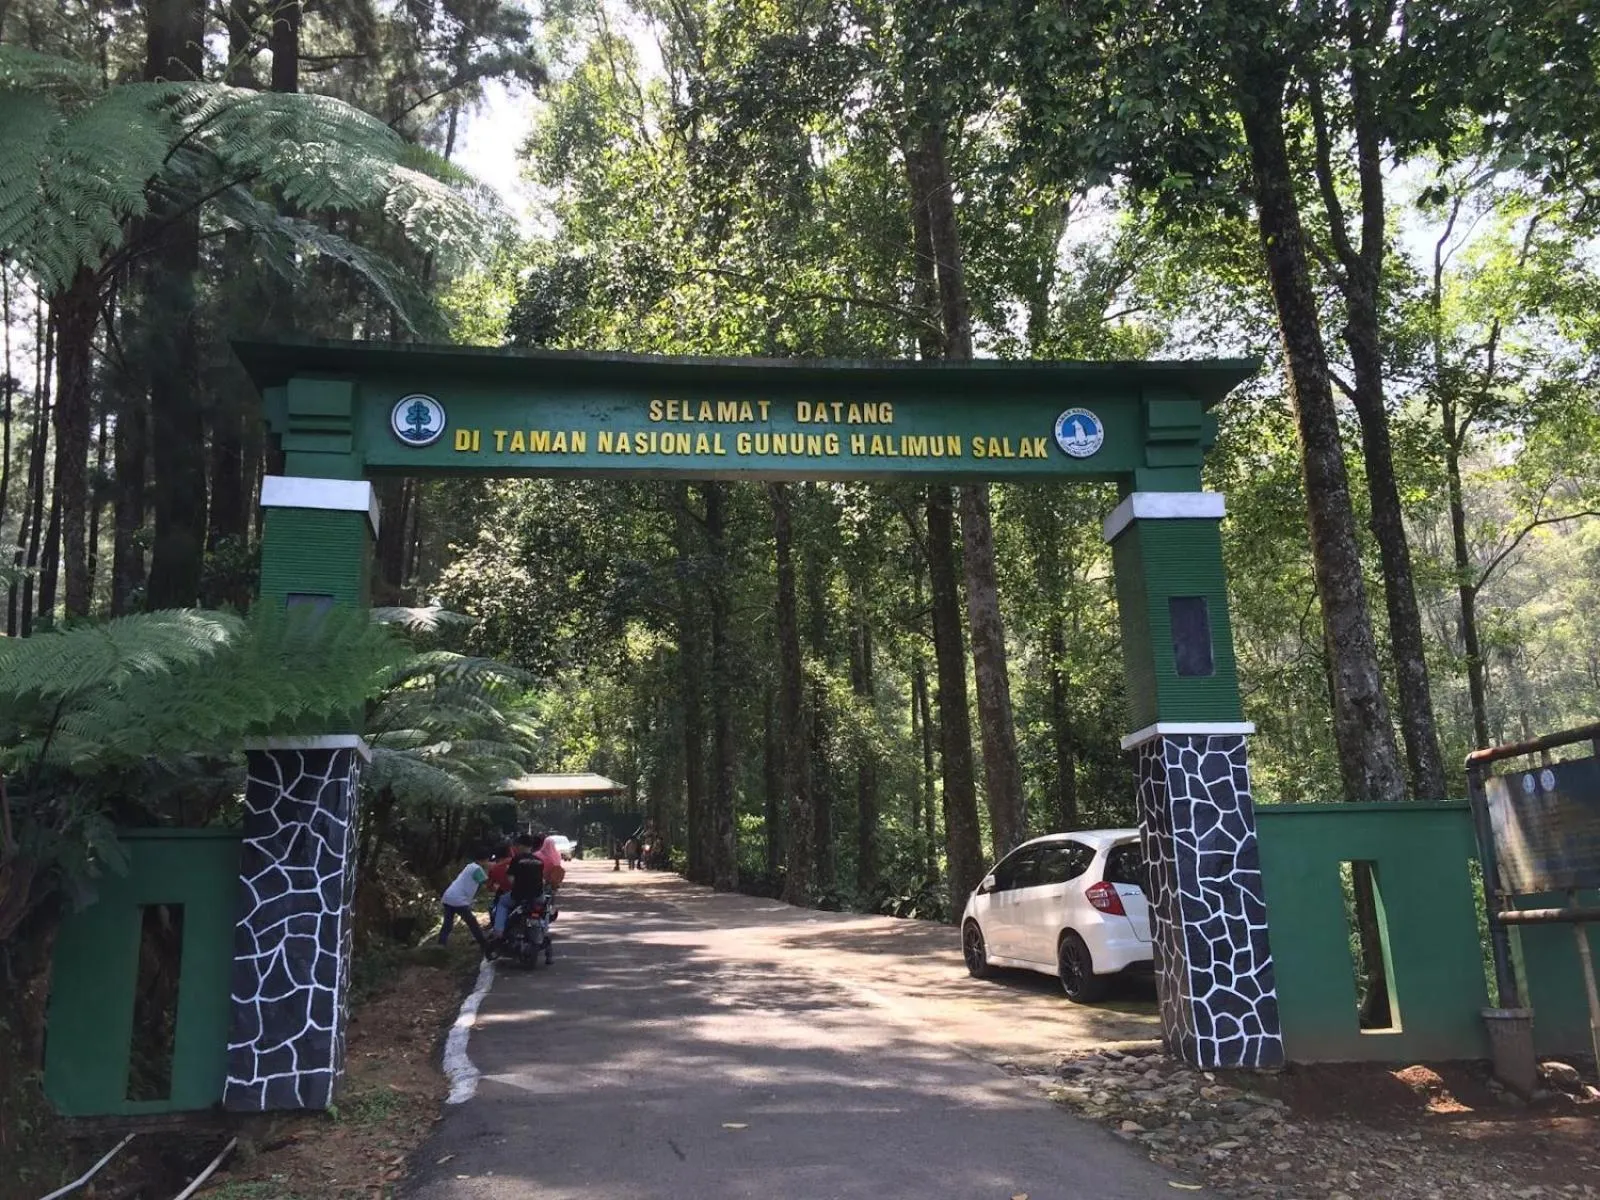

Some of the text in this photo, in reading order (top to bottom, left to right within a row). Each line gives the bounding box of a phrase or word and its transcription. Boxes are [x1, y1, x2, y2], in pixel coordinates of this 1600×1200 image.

[649, 400, 894, 423] SELAMAT DATANG
[455, 429, 481, 452] DI
[494, 430, 587, 453] TAMAN
[597, 432, 726, 455] NASIONAL
[736, 433, 840, 455] GUNUNG
[851, 434, 963, 457] HALIMUN
[972, 436, 1049, 459] SALAK
